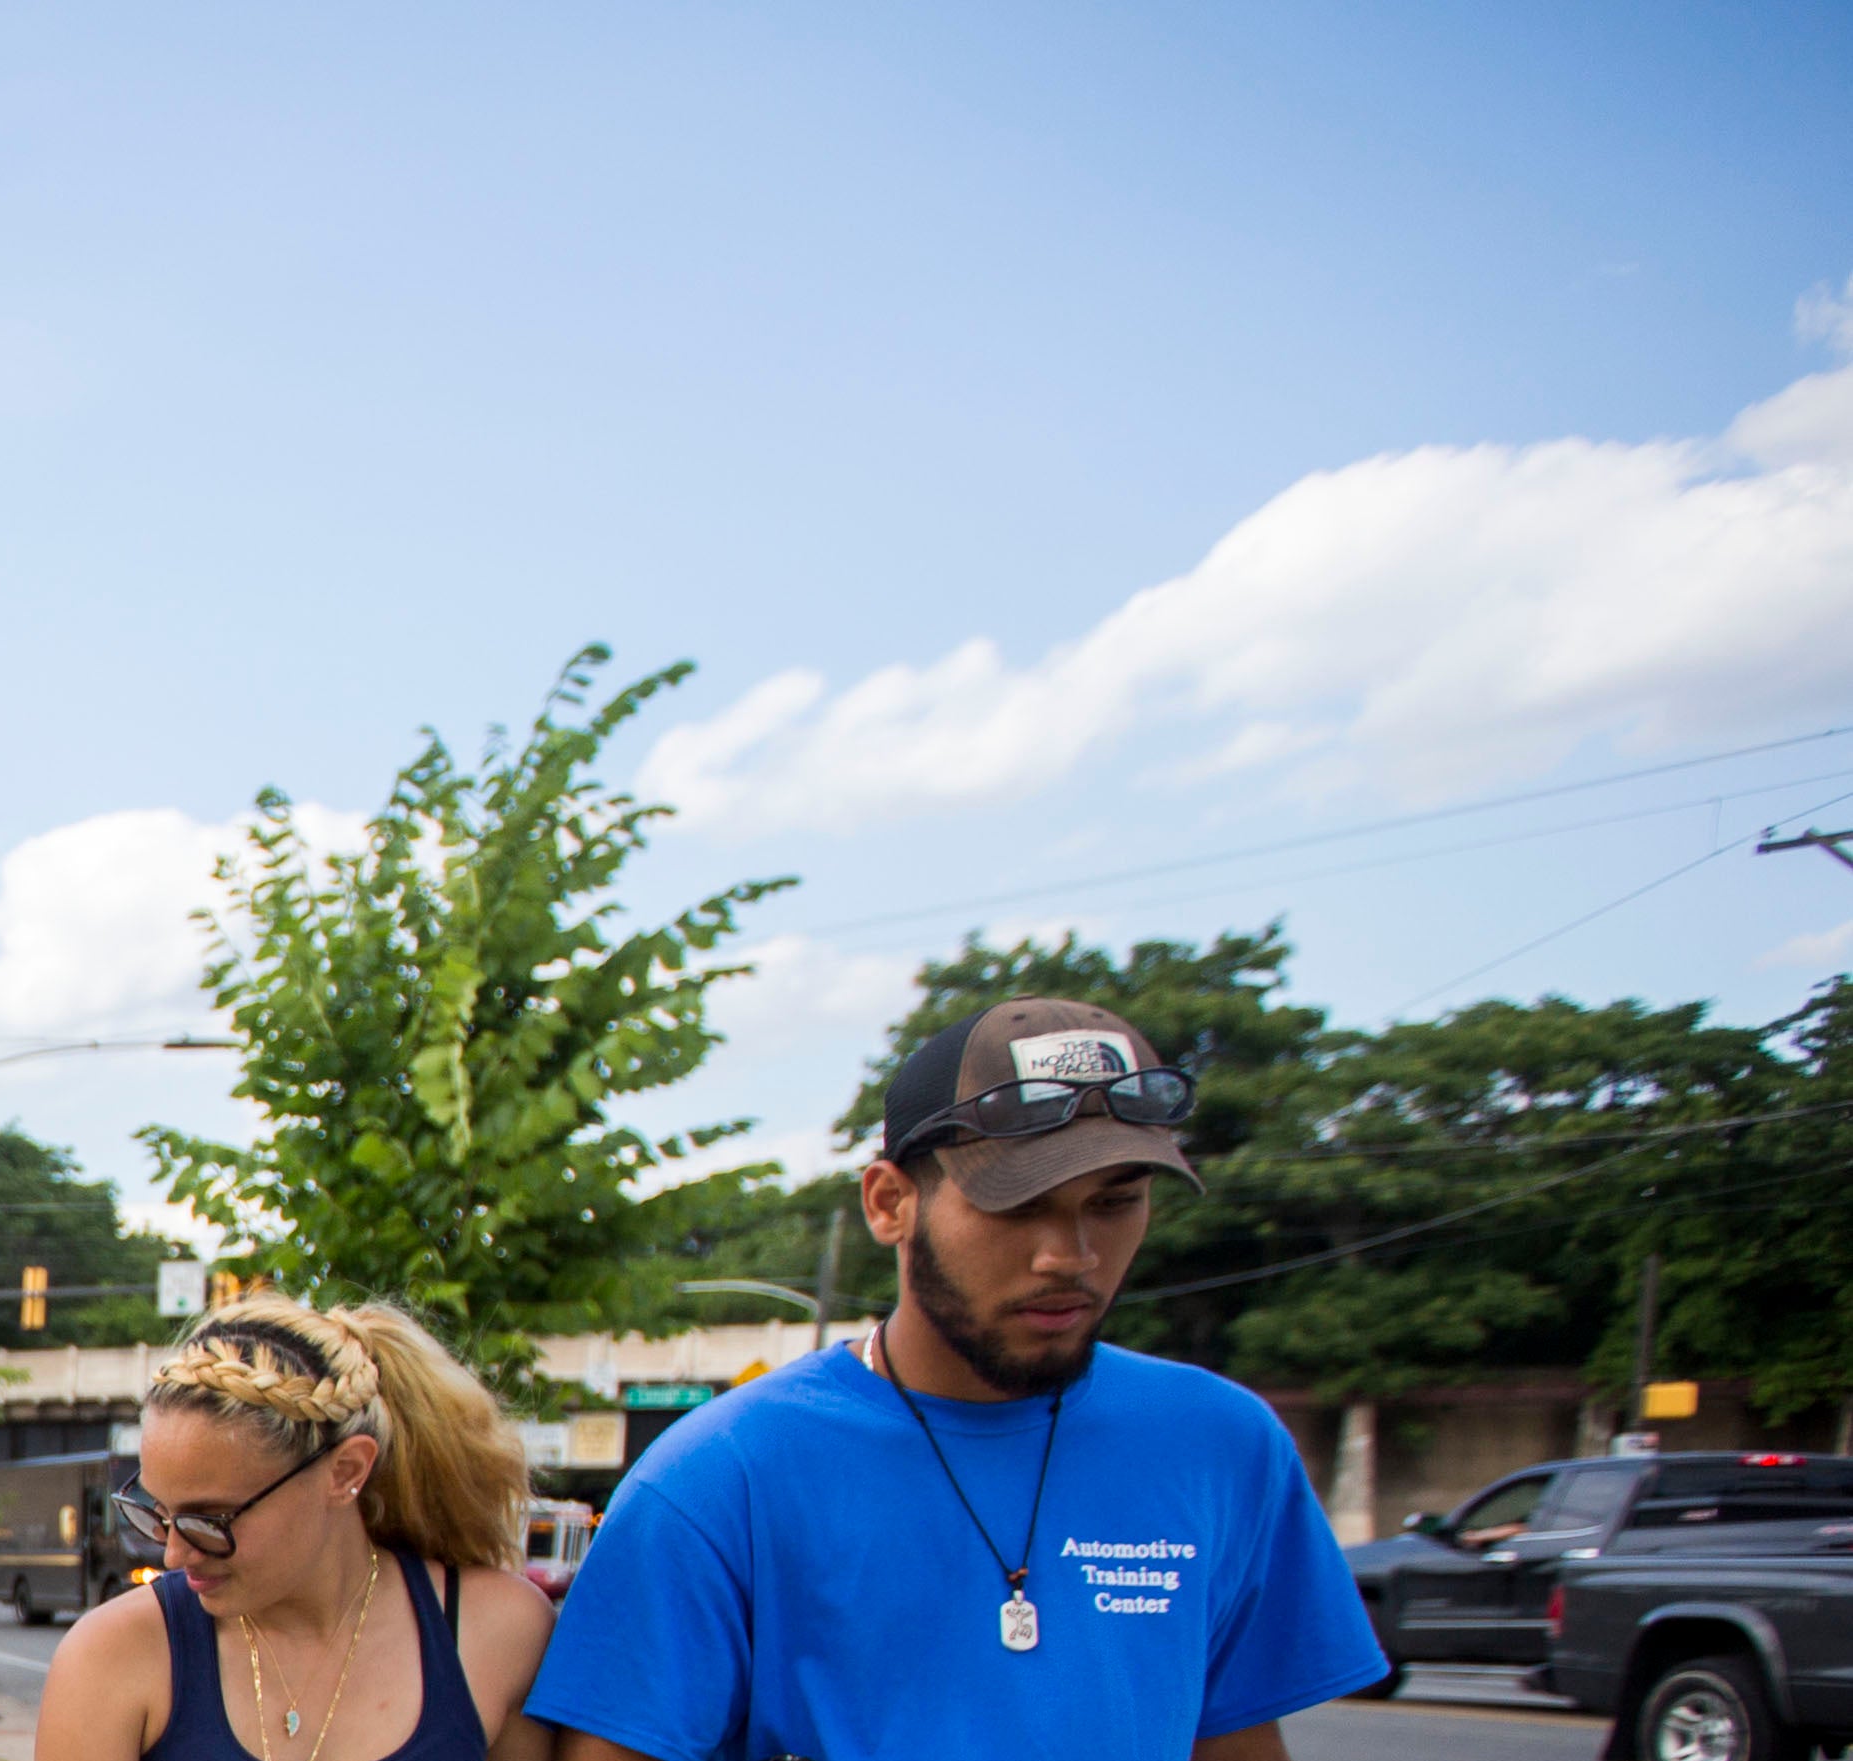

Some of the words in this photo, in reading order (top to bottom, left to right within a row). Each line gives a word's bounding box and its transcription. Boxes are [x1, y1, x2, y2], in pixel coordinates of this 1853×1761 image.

[1060, 1041, 1096, 1053] THE
[1031, 1051, 1100, 1070] NORTH
[1053, 1062, 1102, 1077] FACE
[1059, 1537, 1197, 1560] Automotive
[1081, 1564, 1182, 1591] Training
[1093, 1592, 1172, 1614] Center
